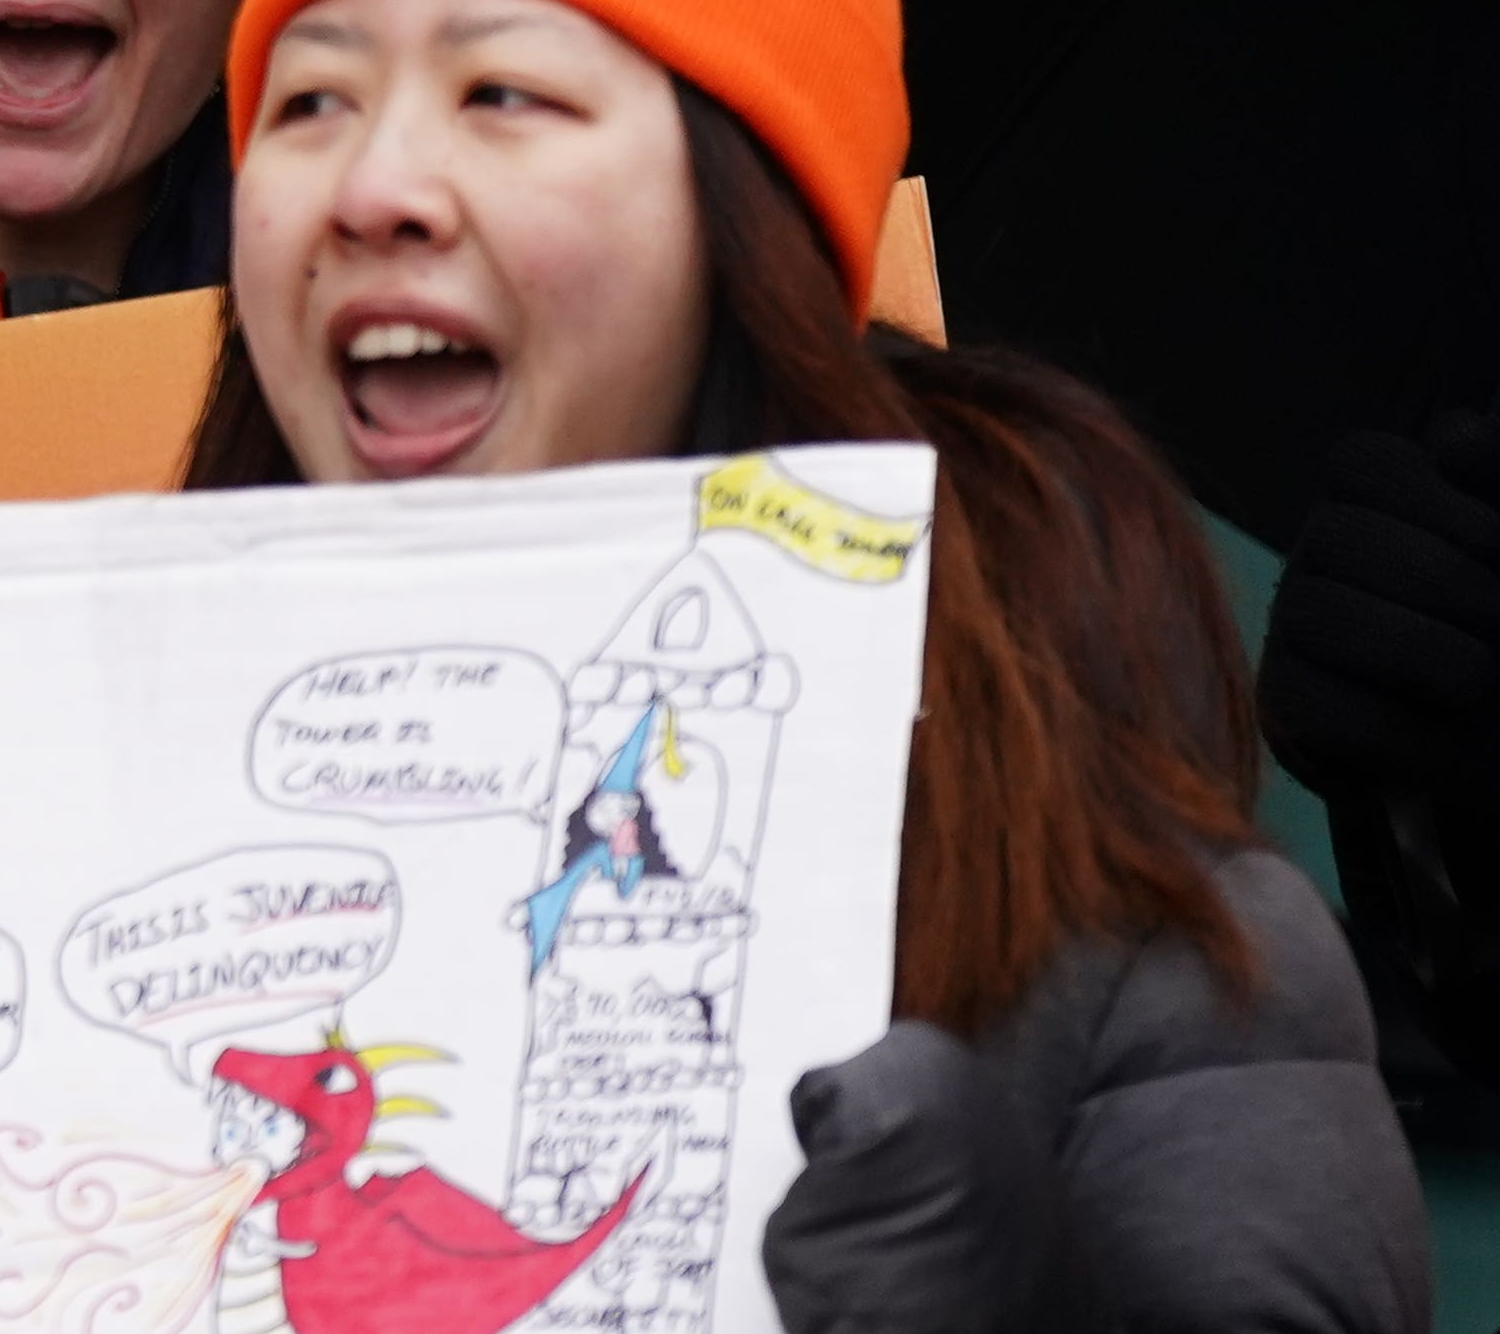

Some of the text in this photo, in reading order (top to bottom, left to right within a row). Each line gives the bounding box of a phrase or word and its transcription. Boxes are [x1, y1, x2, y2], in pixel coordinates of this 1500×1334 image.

[434, 662, 503, 689] THE
[274, 718, 380, 747] TOWER
[108, 937, 385, 1018] DELINQUENCY
